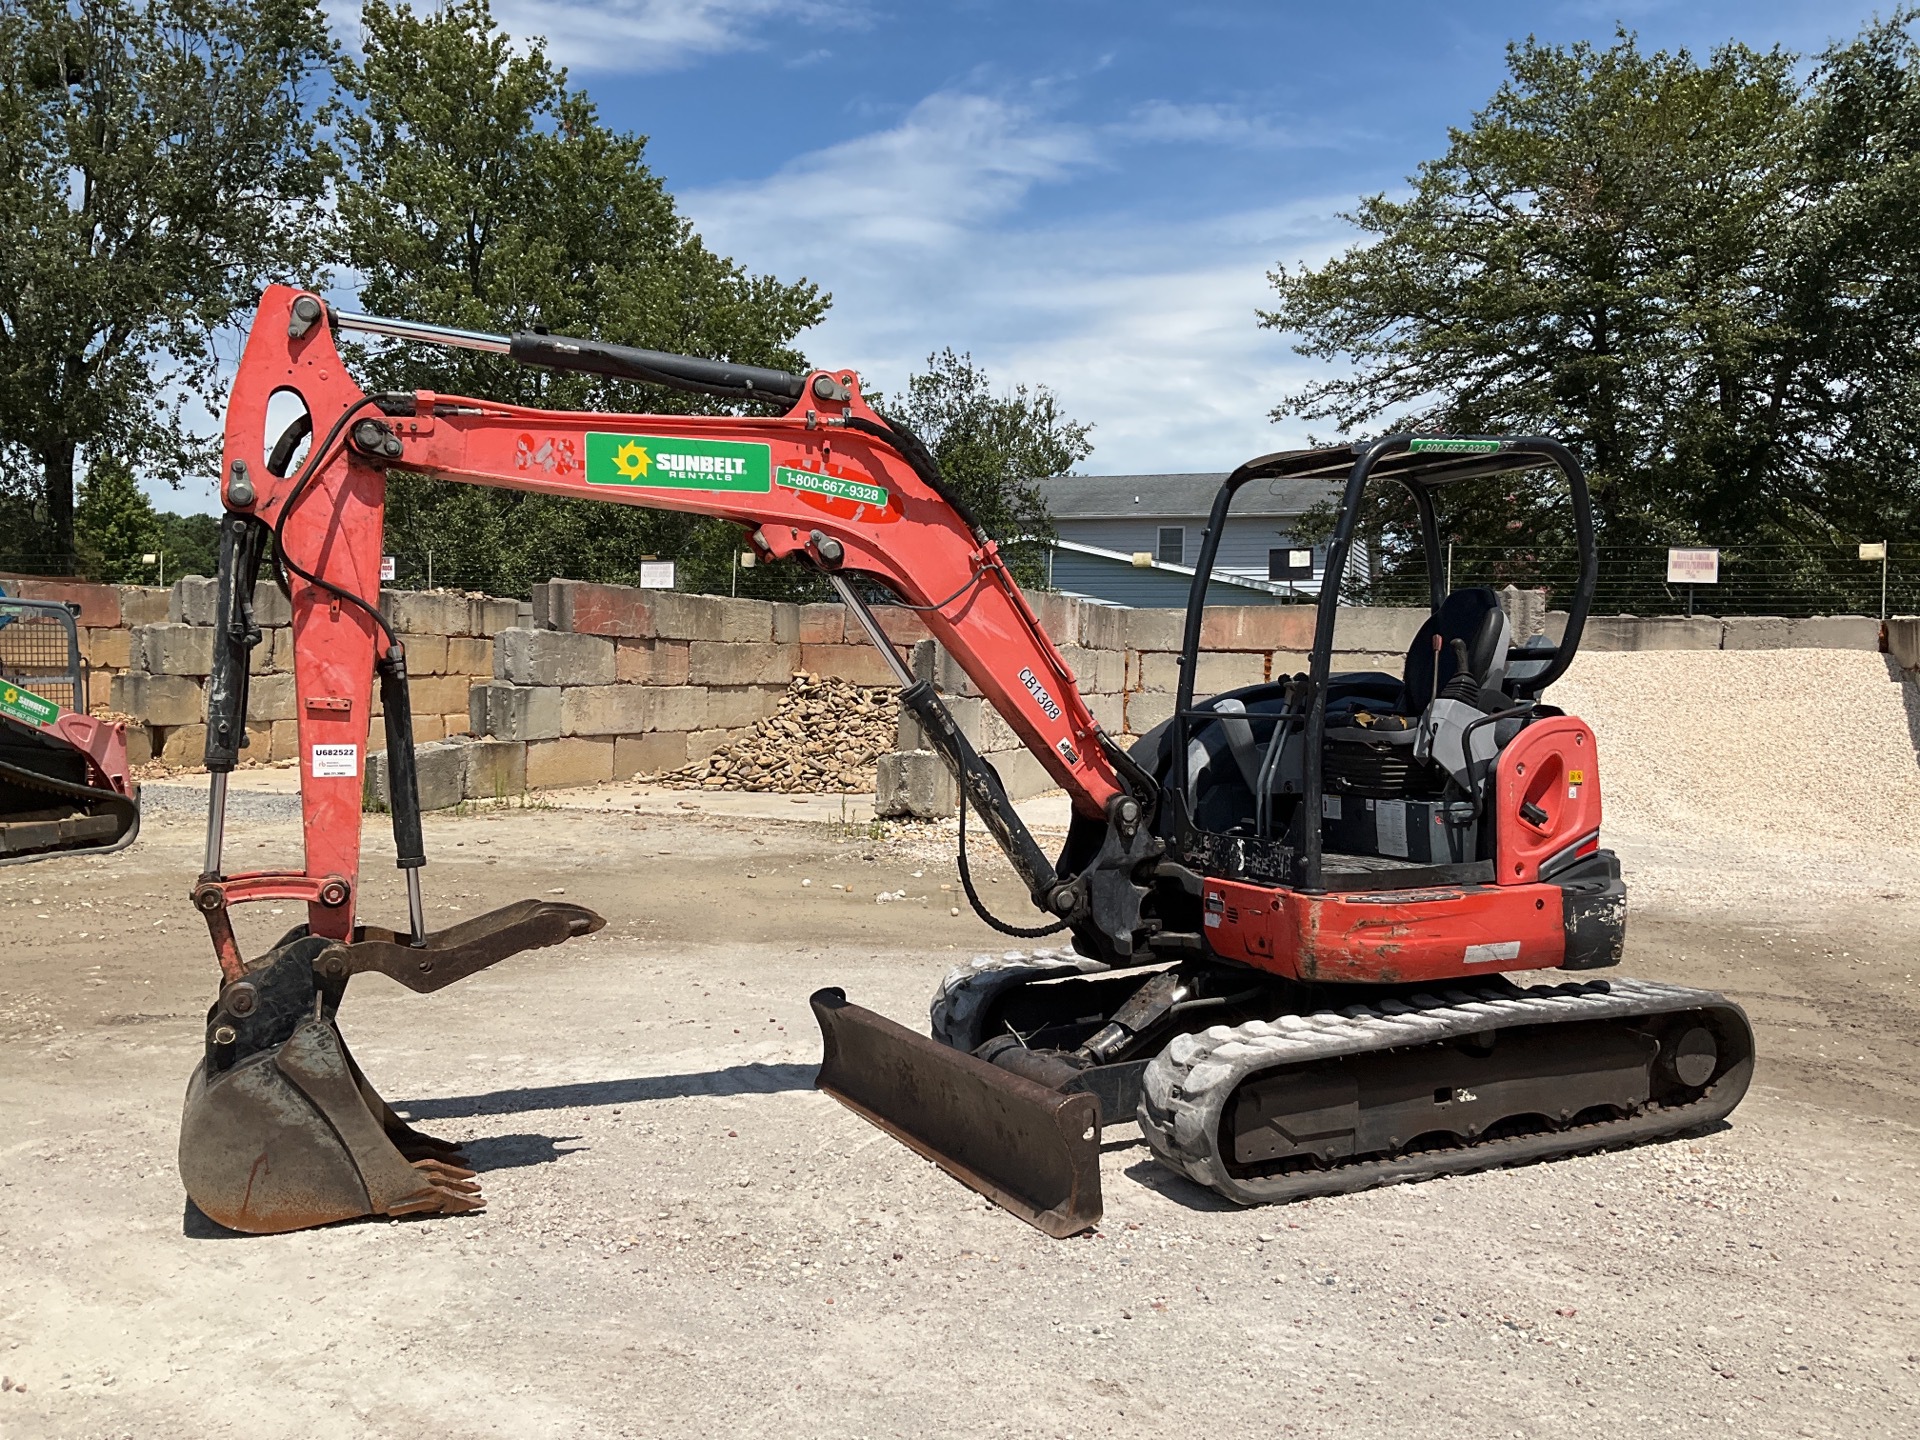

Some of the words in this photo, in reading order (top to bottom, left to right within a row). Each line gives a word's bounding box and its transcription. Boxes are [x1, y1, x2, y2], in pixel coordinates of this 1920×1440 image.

[656, 453, 745, 474] SUNBELT
[669, 471, 732, 481] RENTALS
[786, 472, 879, 501] 1-800-667-9328
[1019, 668, 1060, 720] CB1308
